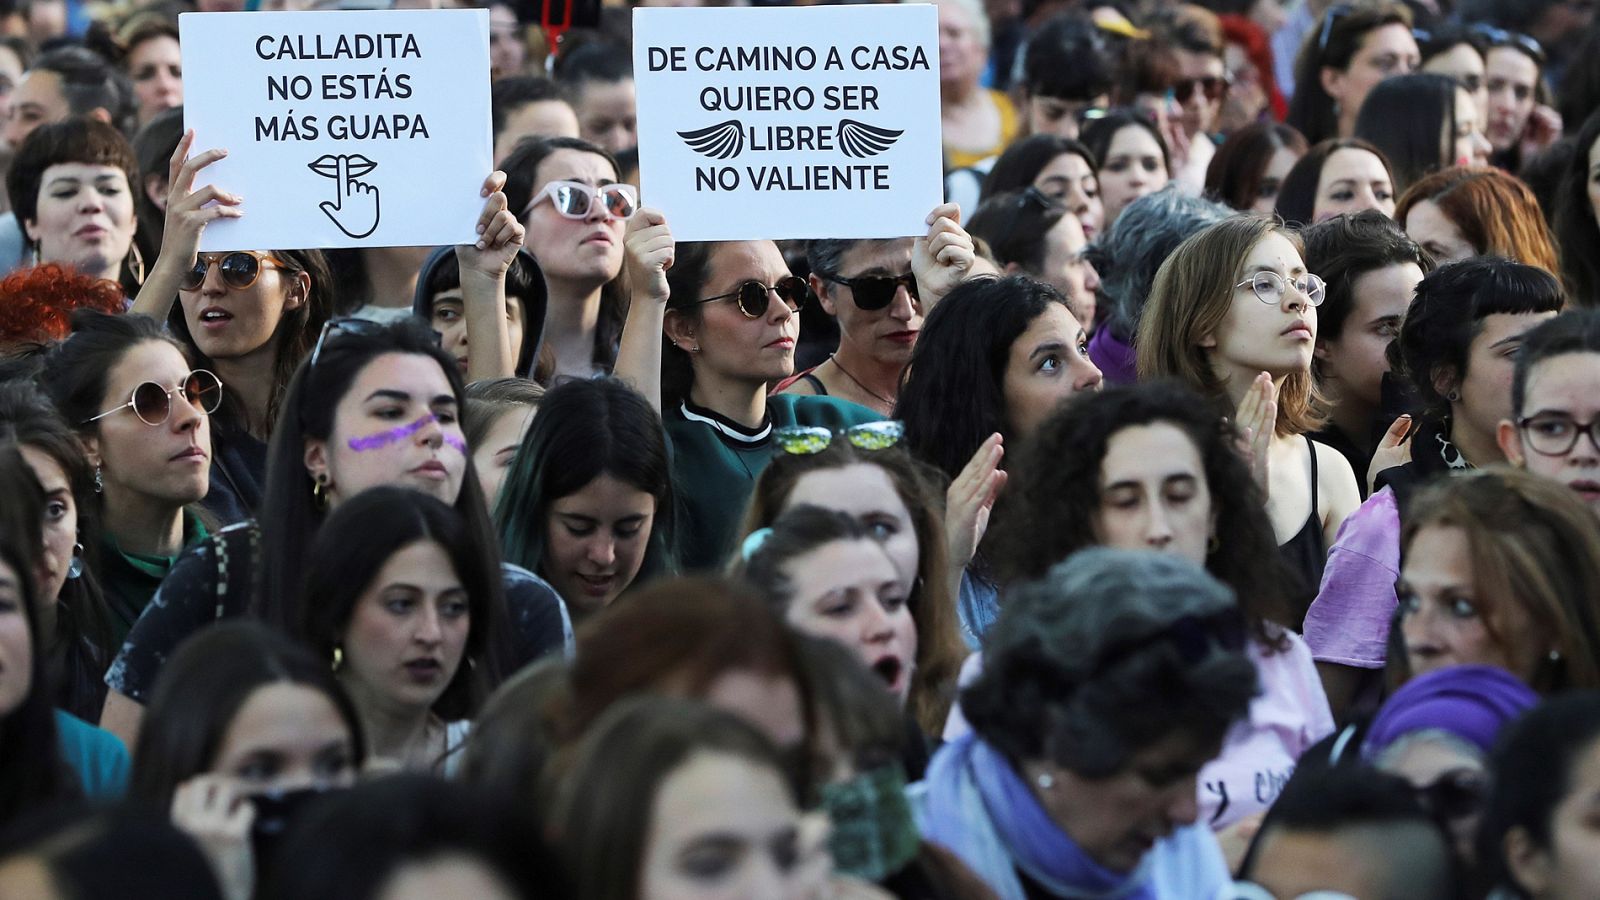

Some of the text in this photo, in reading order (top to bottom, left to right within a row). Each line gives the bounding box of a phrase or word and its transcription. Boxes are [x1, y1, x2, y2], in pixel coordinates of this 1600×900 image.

[255, 33, 422, 61] CALLADITA
[648, 45, 930, 72] DE CAMINO A CASA
[267, 67, 413, 101] NO ESTÁS
[699, 85, 880, 112] QUIERO SER
[254, 108, 430, 142] MÁS GUAPA
[749, 125, 834, 151] LIBRE
[695, 165, 890, 192] NO VALIENTE
